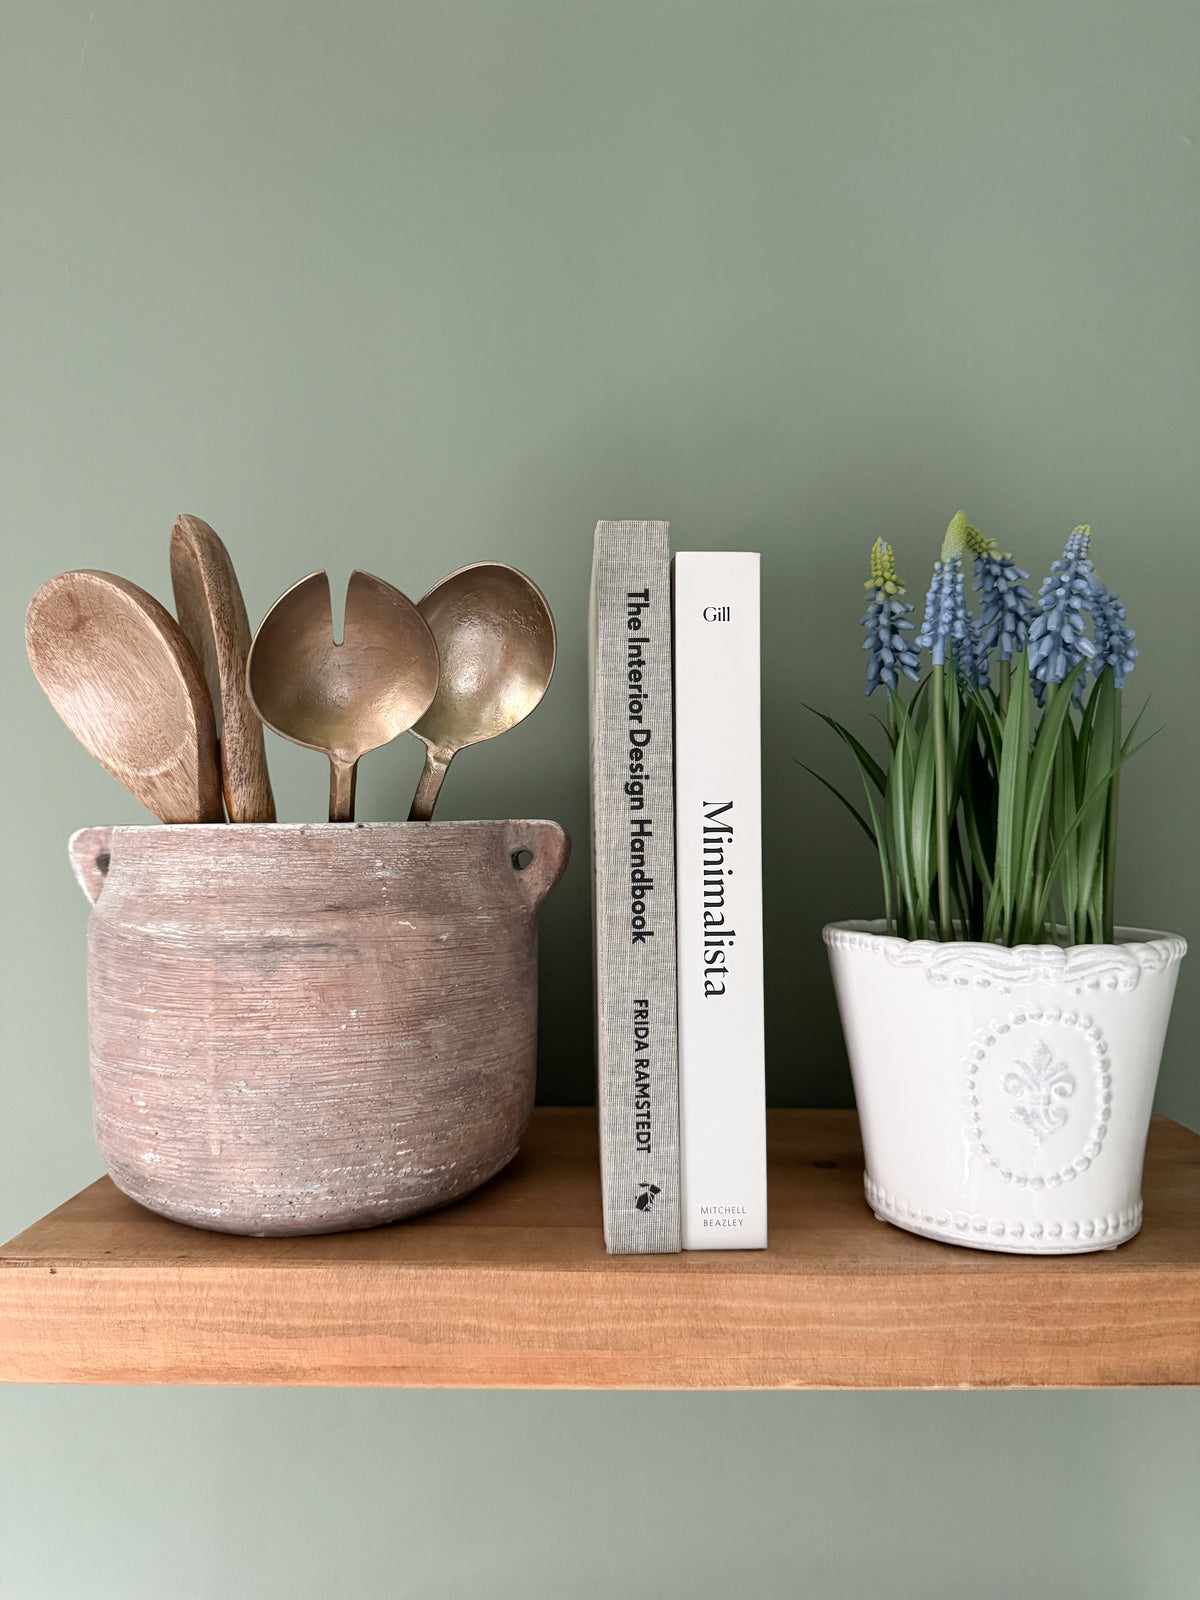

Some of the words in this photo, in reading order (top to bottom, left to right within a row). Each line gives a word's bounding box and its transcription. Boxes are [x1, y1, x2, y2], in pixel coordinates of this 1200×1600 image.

[627, 588, 650, 631] The
[702, 606, 731, 622] Gill
[628, 637, 650, 724] Interior
[624, 729, 651, 811] Design
[630, 819, 655, 945] Handbook
[702, 800, 736, 999] Minimalista
[633, 999, 650, 1052] FRIDA
[634, 1059, 651, 1154] RAMSTEDT
[700, 1205, 746, 1214] MITCHELL
[703, 1219, 744, 1227] BEAZLEY
